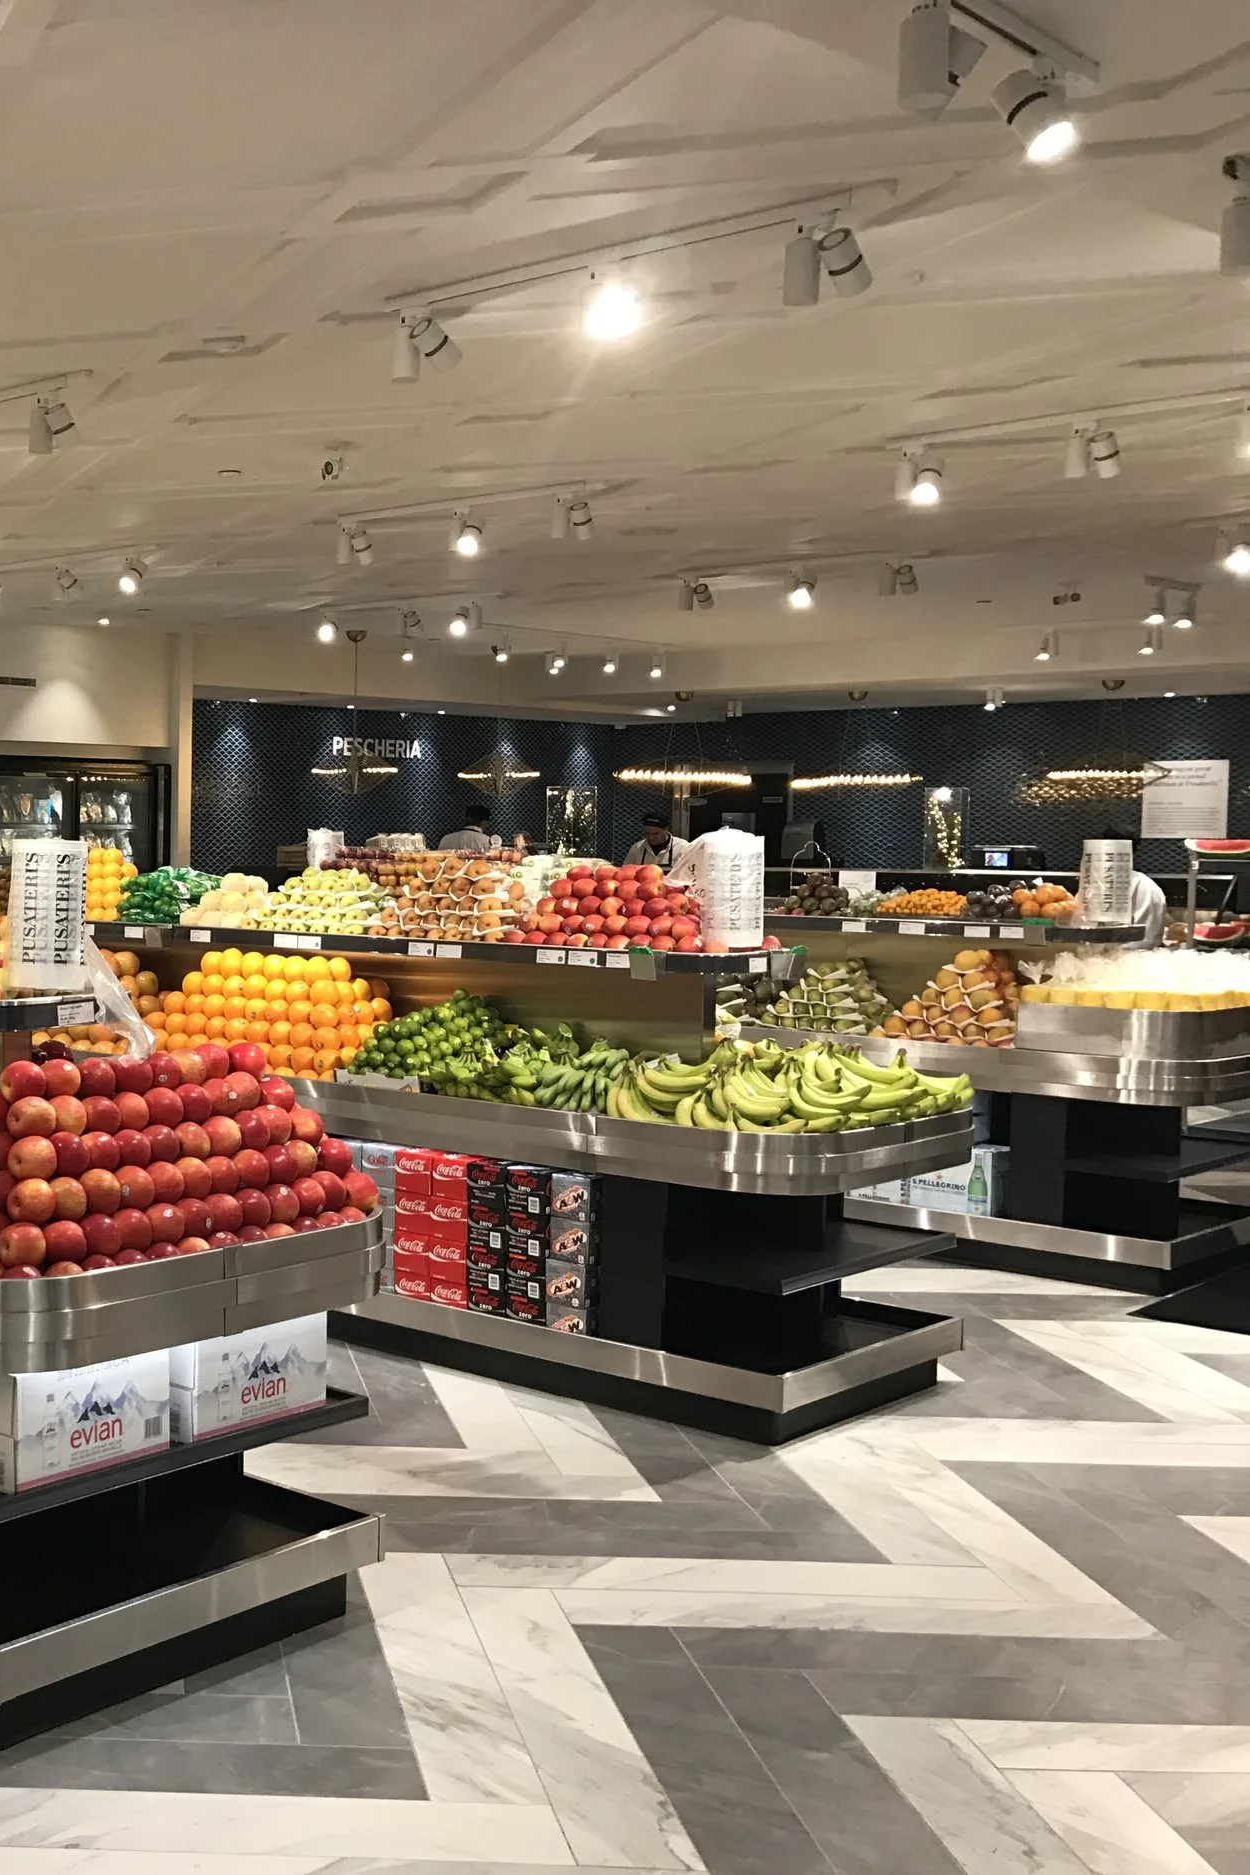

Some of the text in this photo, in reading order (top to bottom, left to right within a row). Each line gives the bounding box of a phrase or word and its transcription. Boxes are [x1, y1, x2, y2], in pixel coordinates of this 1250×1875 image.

[332, 736, 421, 758] PESCHERIA
[22, 852, 39, 964] PUSATERI'S
[54, 854, 71, 965] PUSATERI'S
[241, 1377, 286, 1404] evian
[70, 1418, 123, 1449] evian
